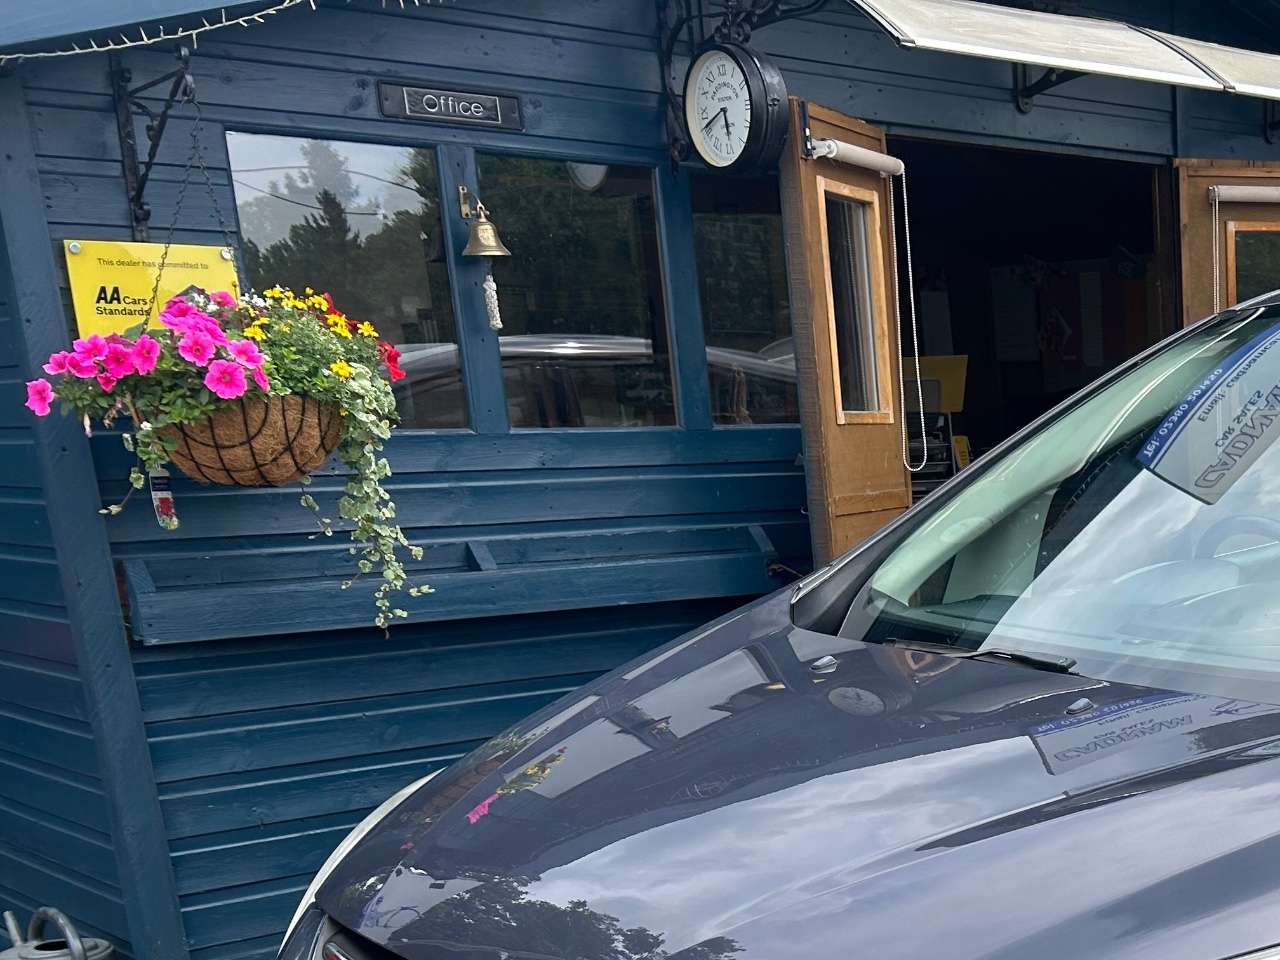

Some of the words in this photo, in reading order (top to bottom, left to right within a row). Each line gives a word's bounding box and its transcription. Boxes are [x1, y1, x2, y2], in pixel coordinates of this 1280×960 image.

[422, 94, 484, 116] Office
[97, 257, 114, 267] This
[115, 258, 141, 268] dealer
[142, 260, 156, 268] has
[200, 262, 209, 270] to
[96, 285, 122, 304] AA
[123, 296, 148, 306] Cars
[96, 306, 150, 317] Standards
